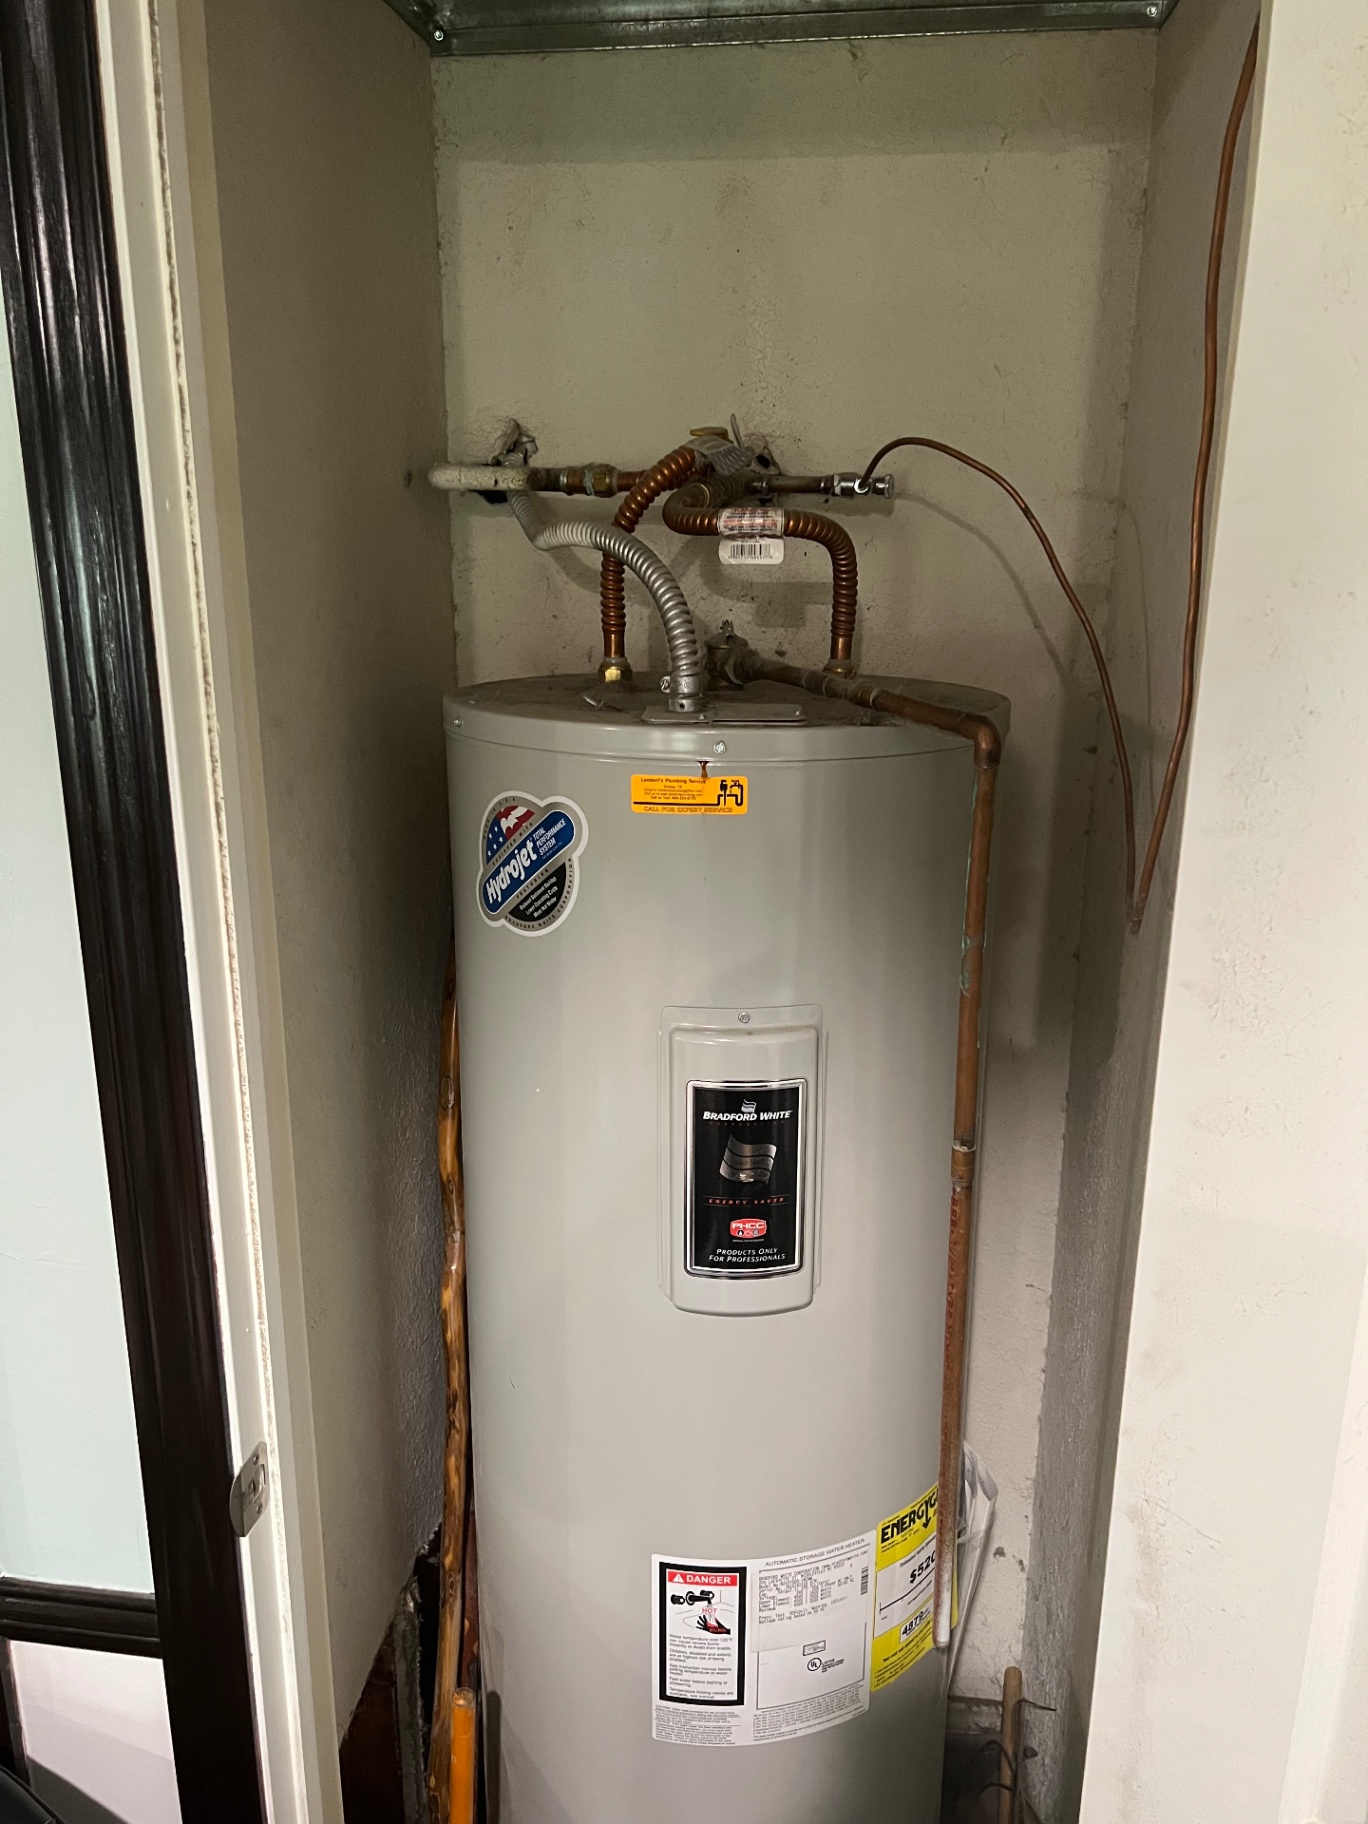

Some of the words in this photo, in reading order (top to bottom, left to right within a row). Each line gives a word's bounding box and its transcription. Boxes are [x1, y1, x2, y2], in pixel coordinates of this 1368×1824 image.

[518, 821, 534, 837] WITH
[532, 826, 546, 841] TOTAL
[535, 818, 567, 849] PERFORMANCE
[538, 837, 557, 856] SYSTEM
[485, 839, 537, 904] Hydrojet
[516, 868, 550, 900] FEATURING
[556, 857, 573, 914] CORPORATION
[703, 1111, 757, 1121] BRADFORD
[759, 1110, 793, 1120] WHITE
[753, 1197, 784, 1205] SAVER
[708, 1254, 725, 1262] FOR
[726, 1253, 786, 1262] PROFESSIONALS
[716, 1248, 756, 1256] PRODUCTS
[765, 1557, 798, 1566] AUTOMATIC
[799, 1551, 825, 1562] STORAGE
[826, 1545, 844, 1554] WATER
[845, 1538, 865, 1549] HEATER
[686, 1574, 731, 1584] DANGER
